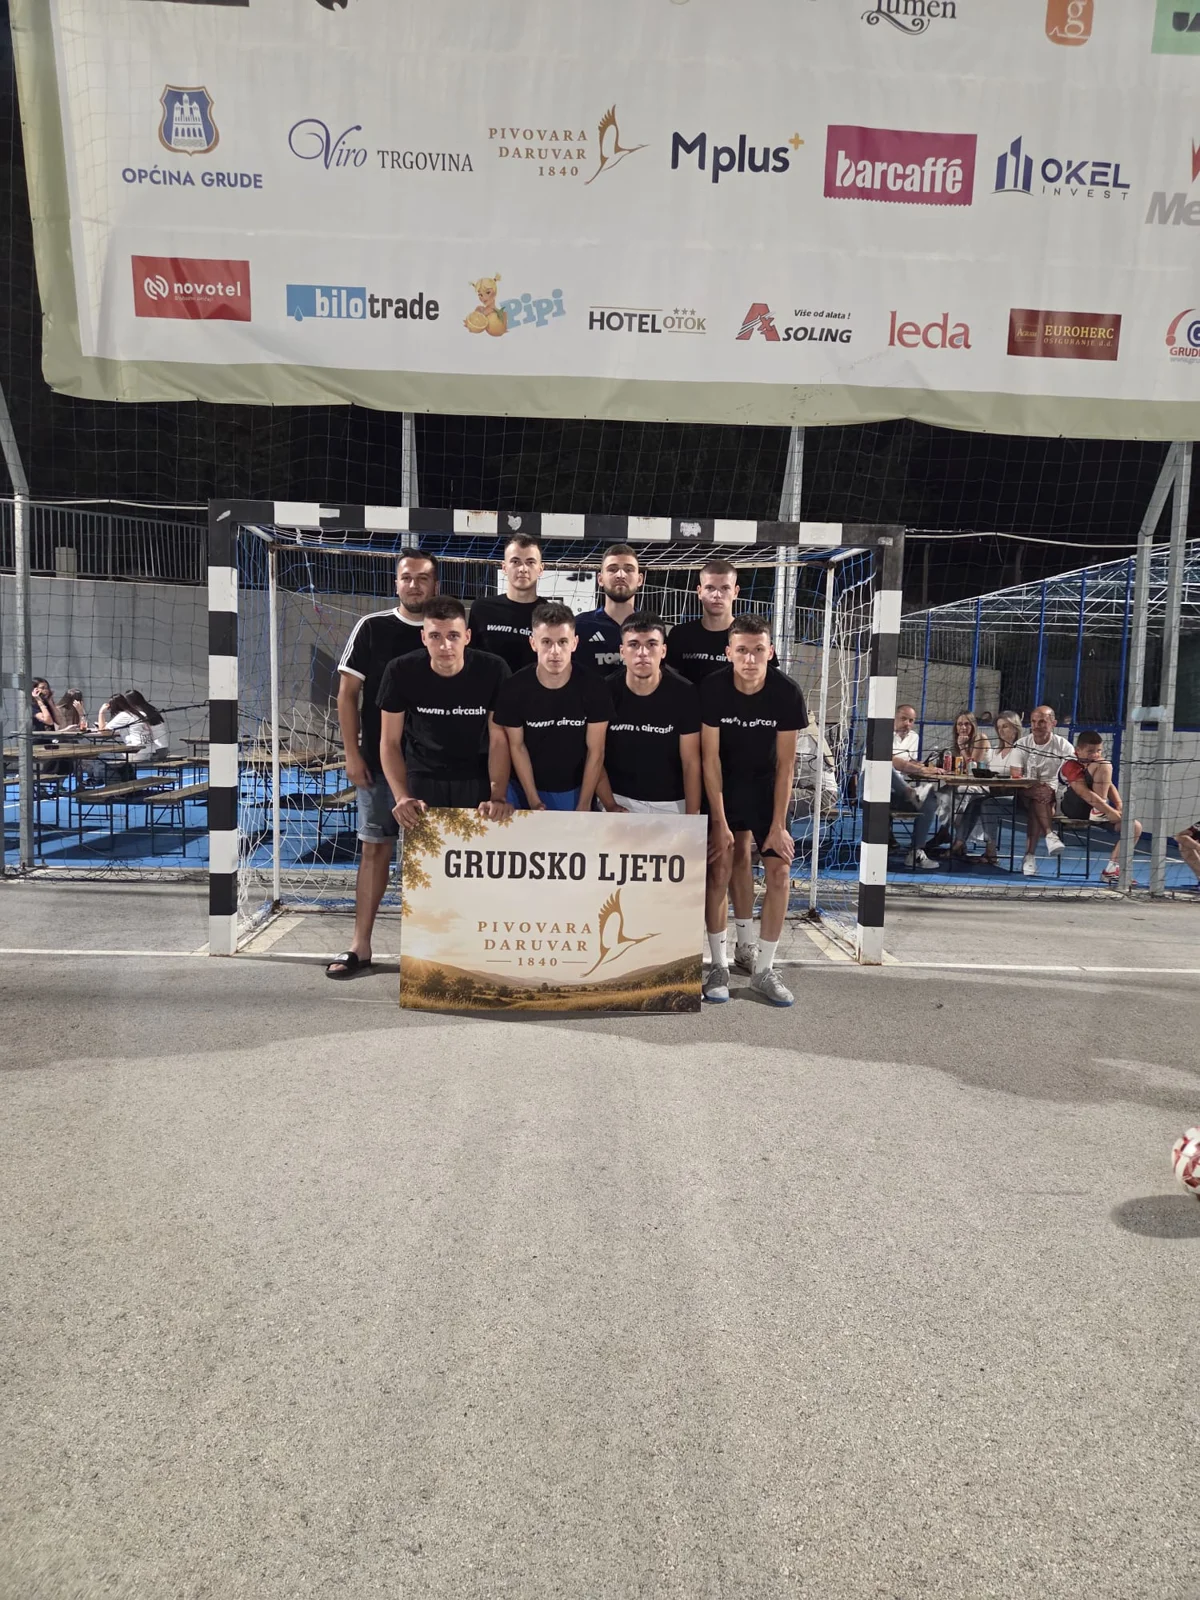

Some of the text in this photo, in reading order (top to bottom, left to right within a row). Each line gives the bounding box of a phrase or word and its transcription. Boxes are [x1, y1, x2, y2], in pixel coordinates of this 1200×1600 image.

[488, 128, 588, 141] PIVOVARA
[288, 118, 474, 172] Viro TRGOVINA
[498, 147, 587, 160] DARUVAR
[122, 164, 263, 189] OPĆINA GRUDE
[538, 166, 579, 177] 1840
[835, 150, 964, 194] barcaffé
[1041, 158, 1130, 189] OKEL
[1042, 185, 1129, 200] INVEST
[173, 281, 241, 297] novotel
[502, 288, 567, 331] Pipi
[813, 310, 824, 318] od
[588, 311, 707, 333] HOTEL OTOK
[889, 310, 972, 350] leda
[1044, 324, 1115, 339] EUROHERC
[1043, 337, 1094, 347] OSIGURANJE
[452, 705, 487, 716] aircash
[556, 716, 588, 727] aircas
[444, 849, 685, 886] GRUDSKO LJETO
[478, 920, 593, 934] PIVOVARA
[484, 939, 589, 952] DARUVAR
[517, 956, 558, 967] 1840
